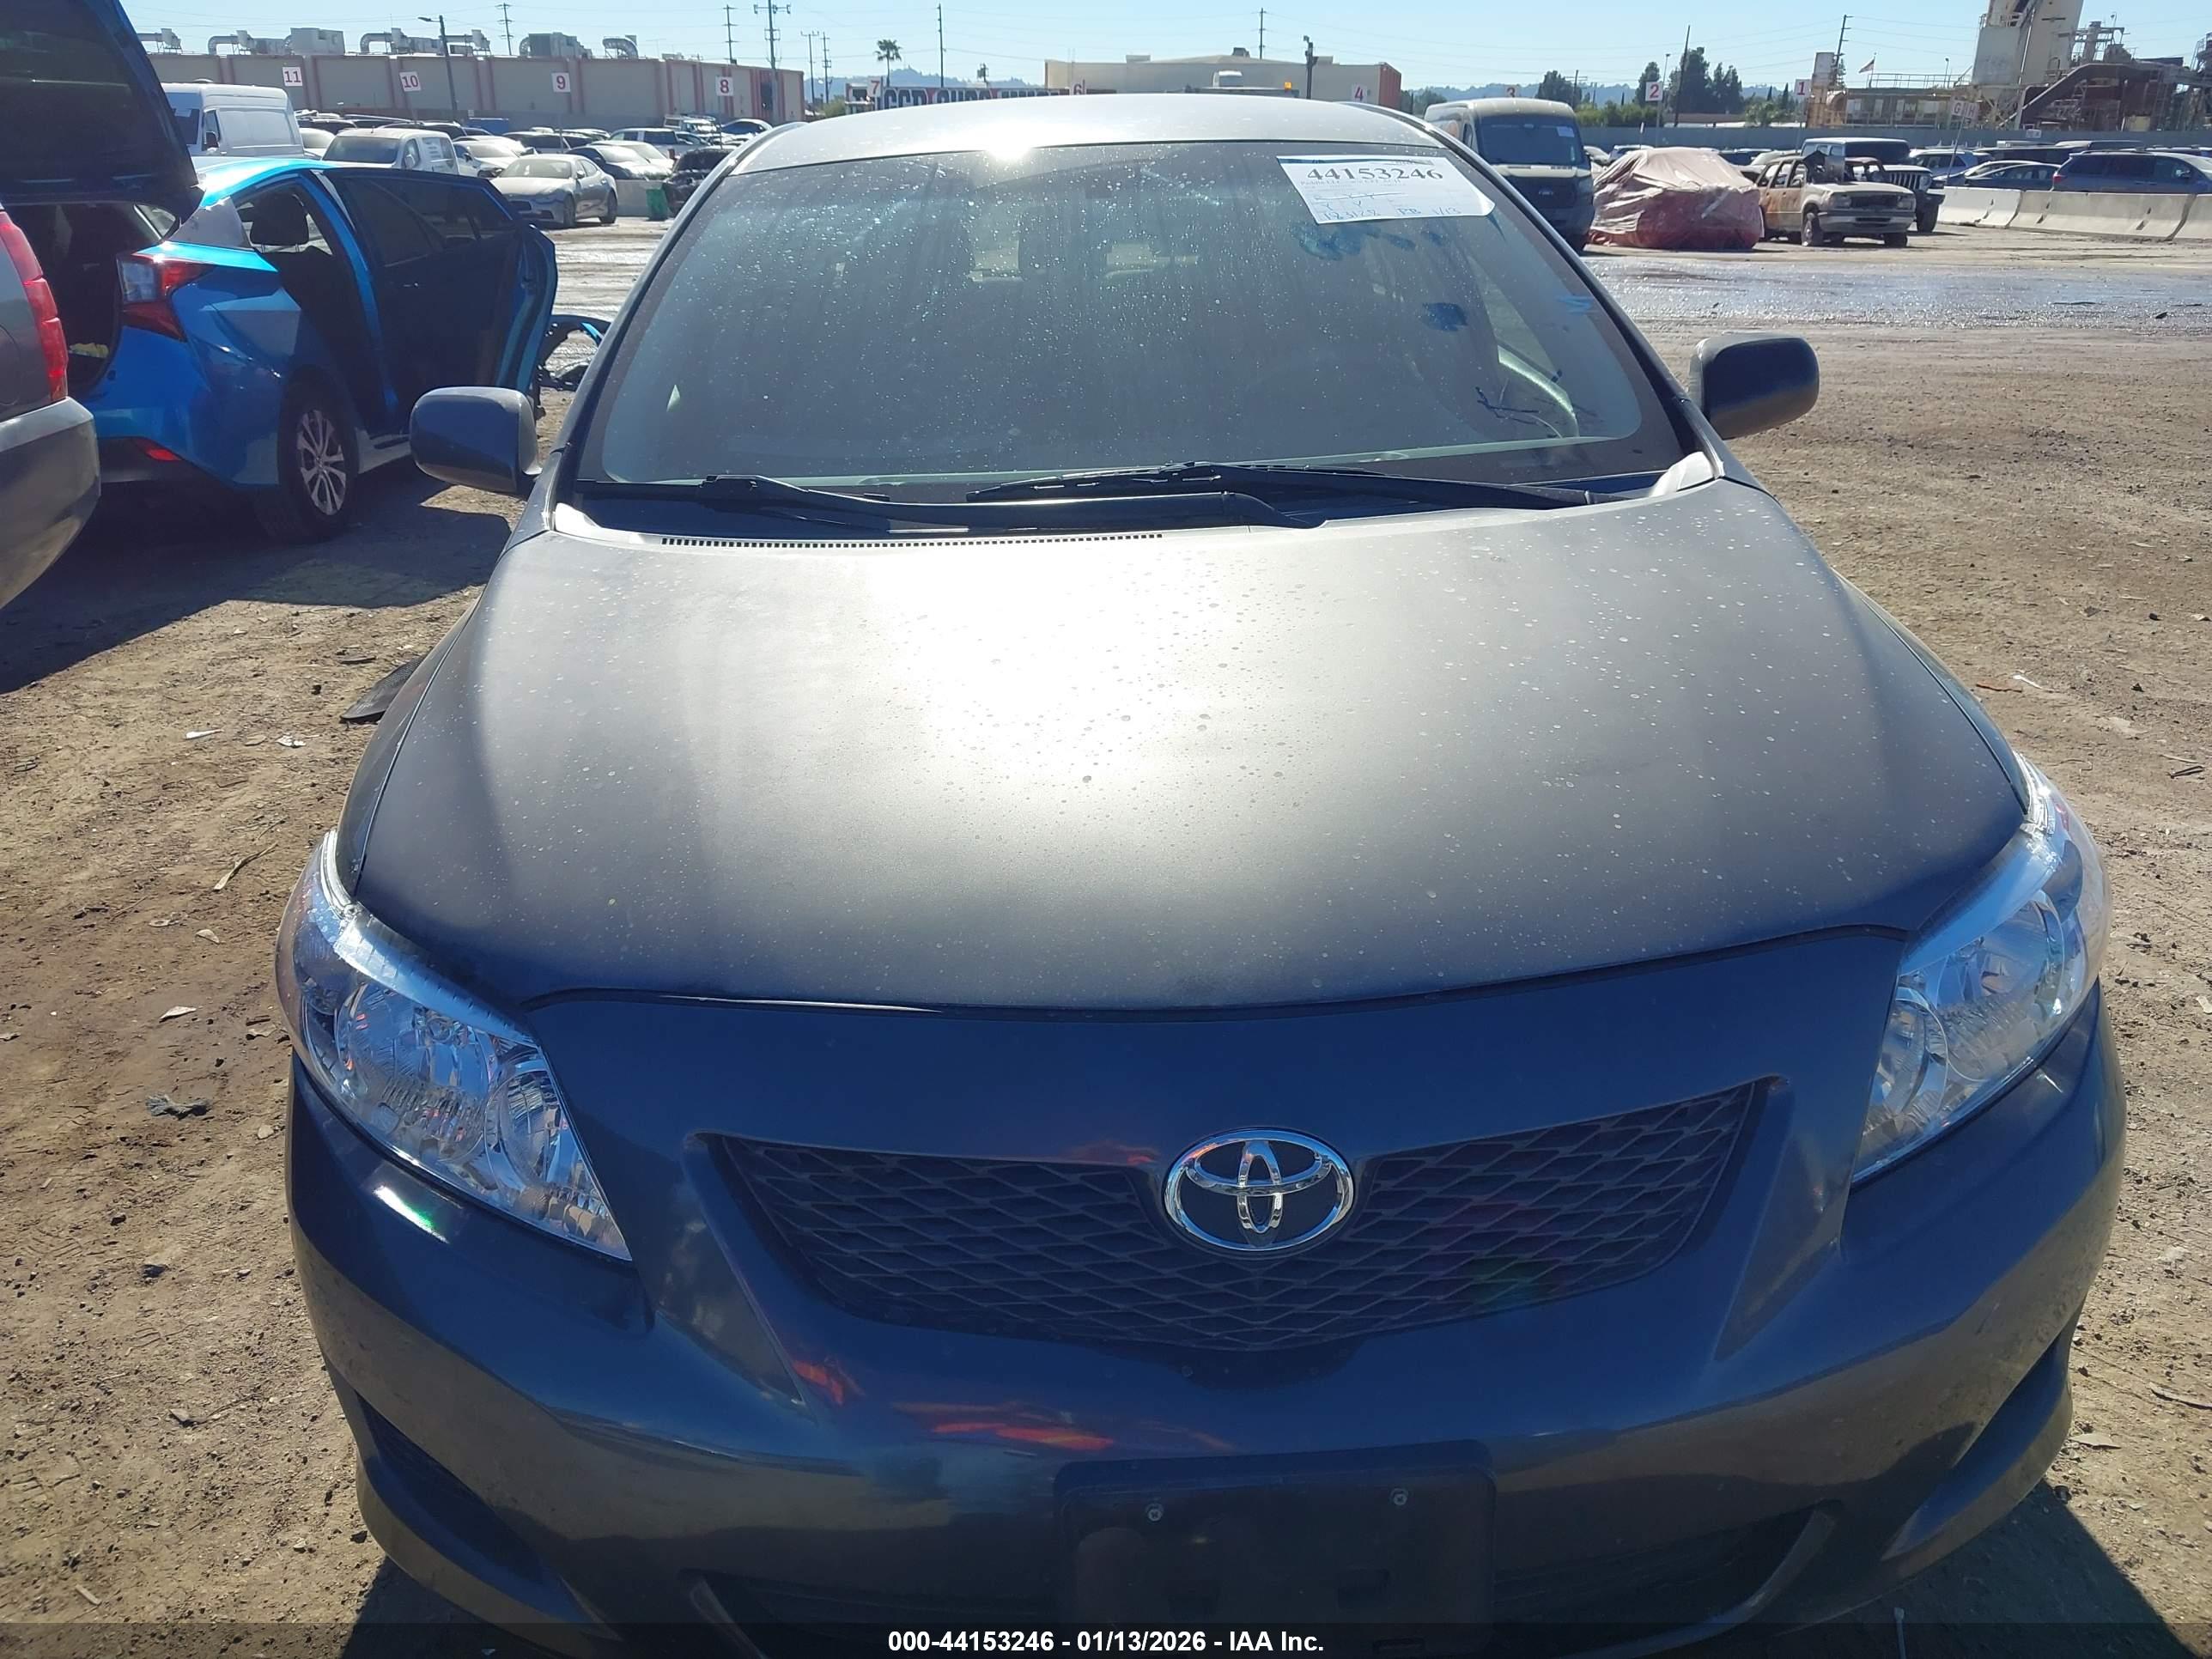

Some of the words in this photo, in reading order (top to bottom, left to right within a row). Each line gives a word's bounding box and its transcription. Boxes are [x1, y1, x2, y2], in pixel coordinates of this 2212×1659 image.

[283, 70, 301, 83] 11
[402, 75, 419, 88] 10
[556, 75, 567, 90] 9
[720, 79, 730, 94] 8
[870, 80, 880, 94] 7
[1354, 85, 1364, 101] 4
[1649, 83, 1660, 99] 2
[1796, 81, 1806, 96] 1
[1307, 167, 1443, 180] 44153246
